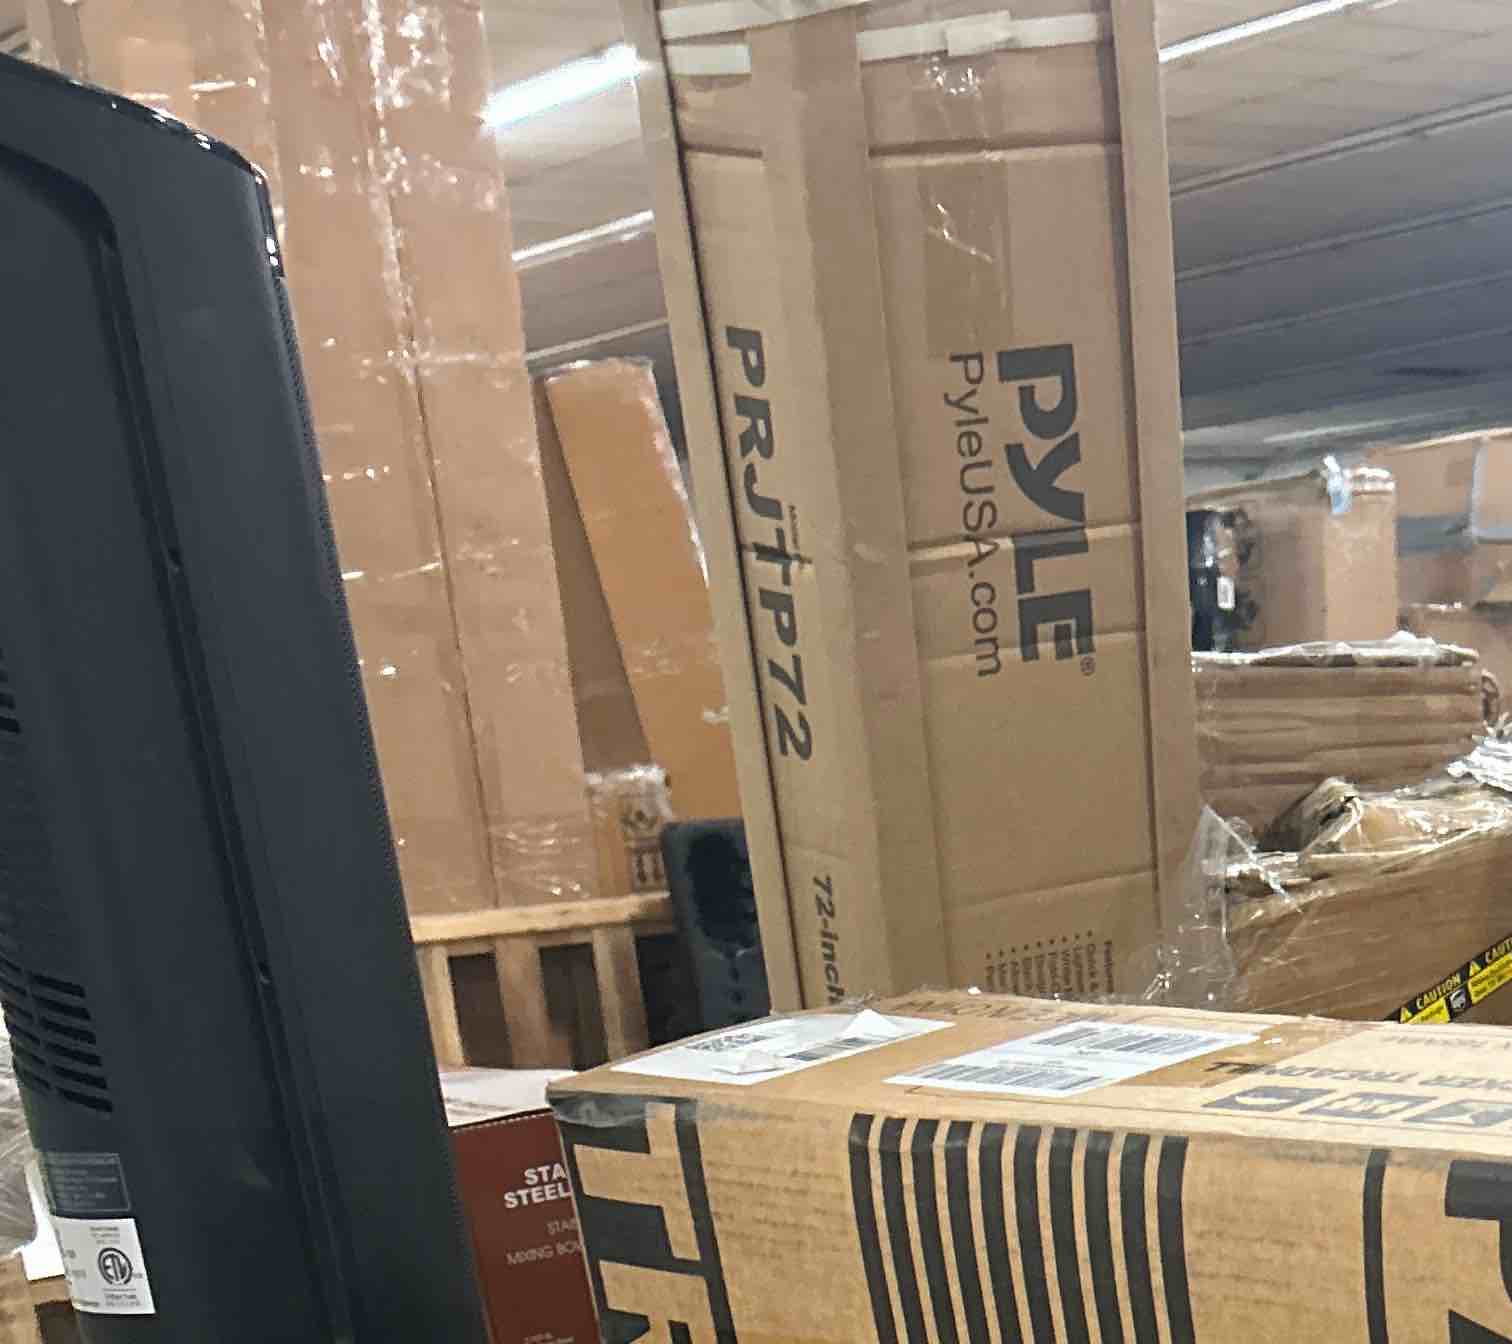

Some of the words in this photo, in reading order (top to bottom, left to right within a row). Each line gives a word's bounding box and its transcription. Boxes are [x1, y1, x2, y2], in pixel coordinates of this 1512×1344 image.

[725, 326, 812, 762] PRJTP72
[943, 351, 1003, 678] PyleUSA.com
[1415, 971, 1462, 1011] CAUTION
[504, 1182, 572, 1209] STEEL
